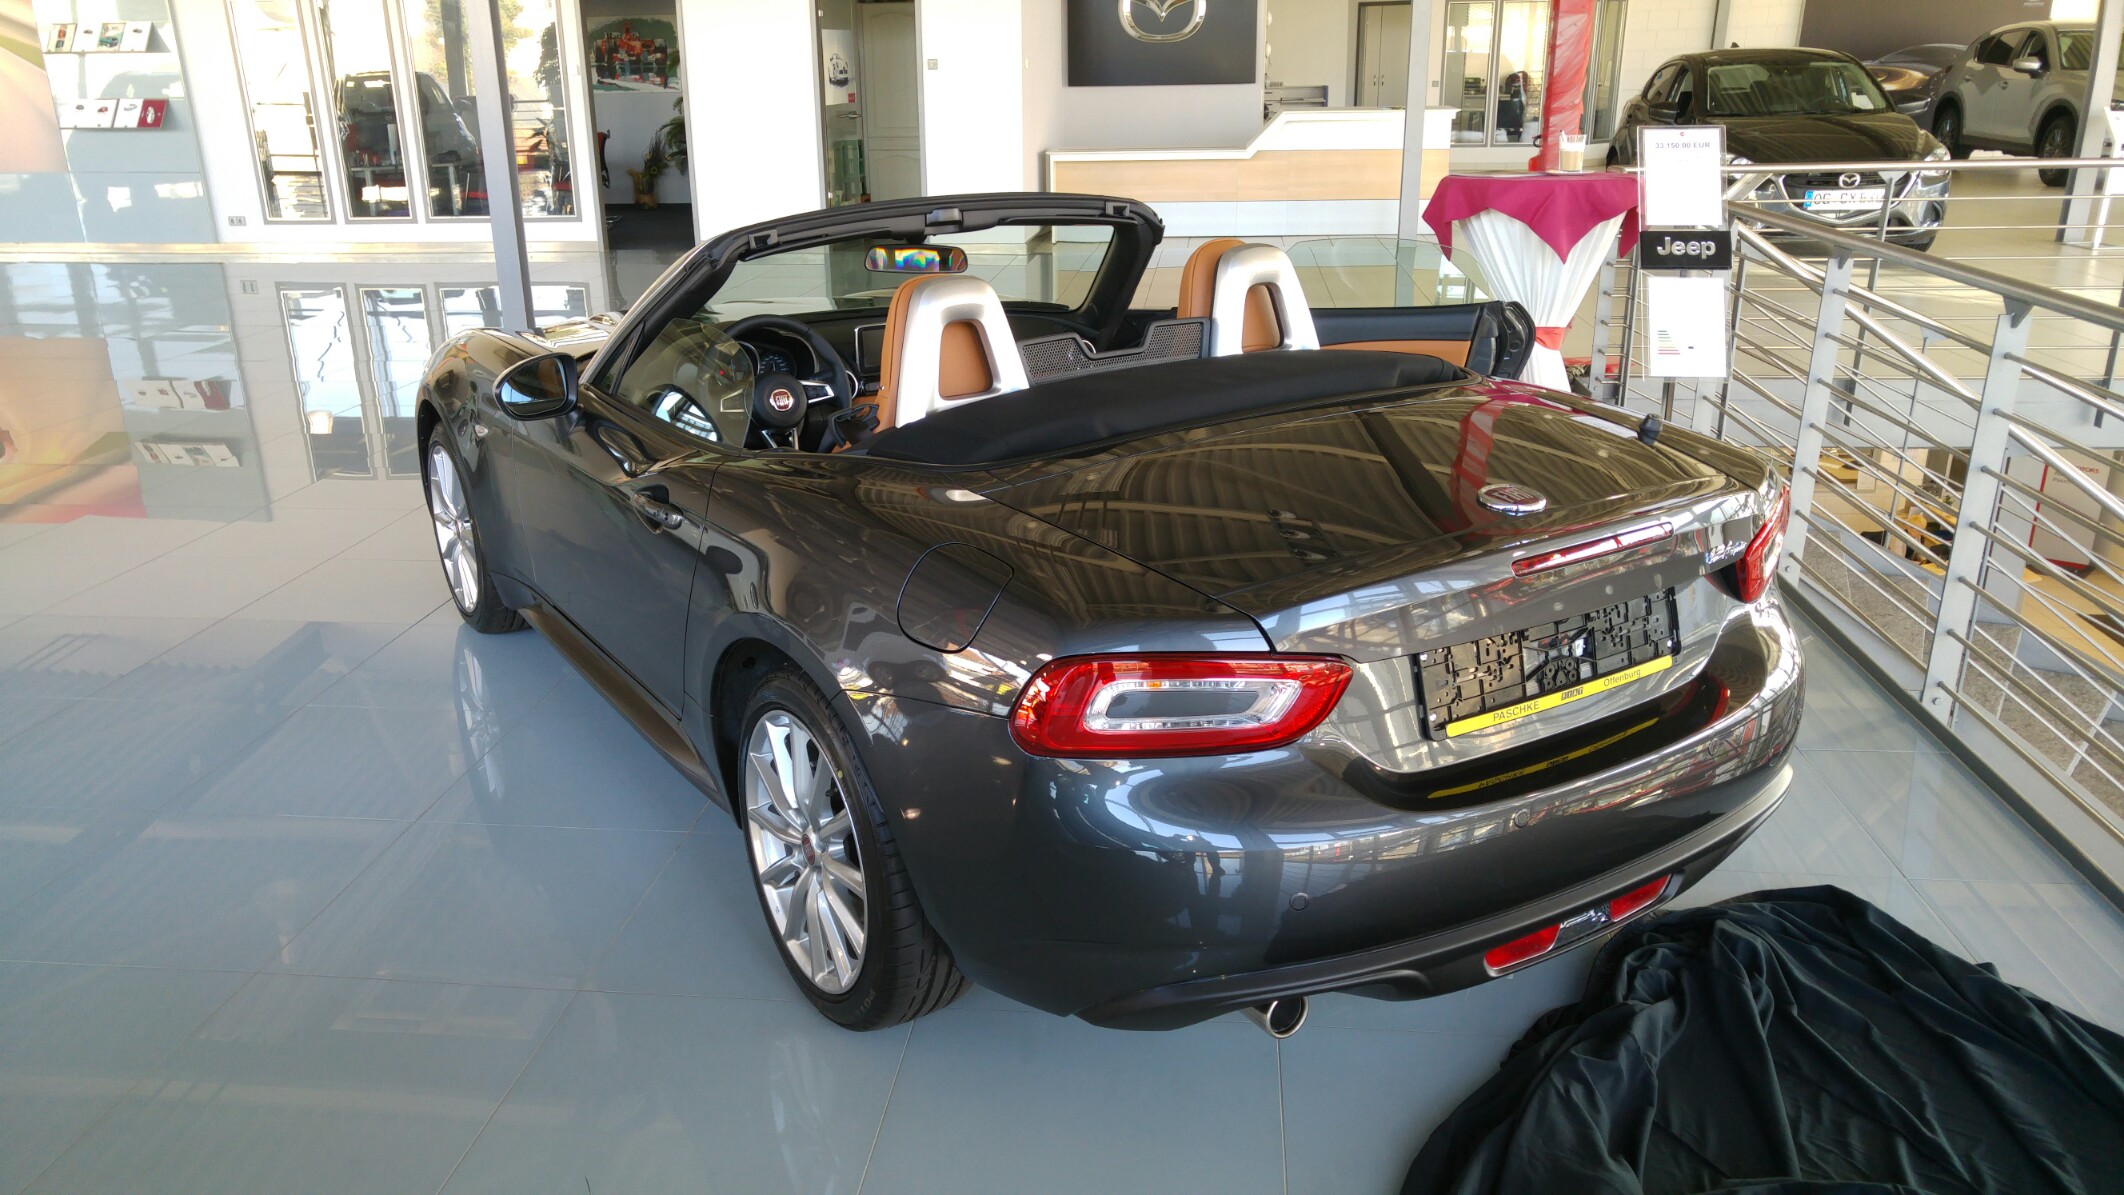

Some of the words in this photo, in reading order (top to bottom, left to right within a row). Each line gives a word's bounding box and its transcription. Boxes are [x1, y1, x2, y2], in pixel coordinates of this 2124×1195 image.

[1657, 237, 1716, 260] Jeep
[1492, 487, 1534, 503] FIAT
[1493, 701, 1540, 722] PASCHKE
[1603, 668, 1641, 687] Offenburg
